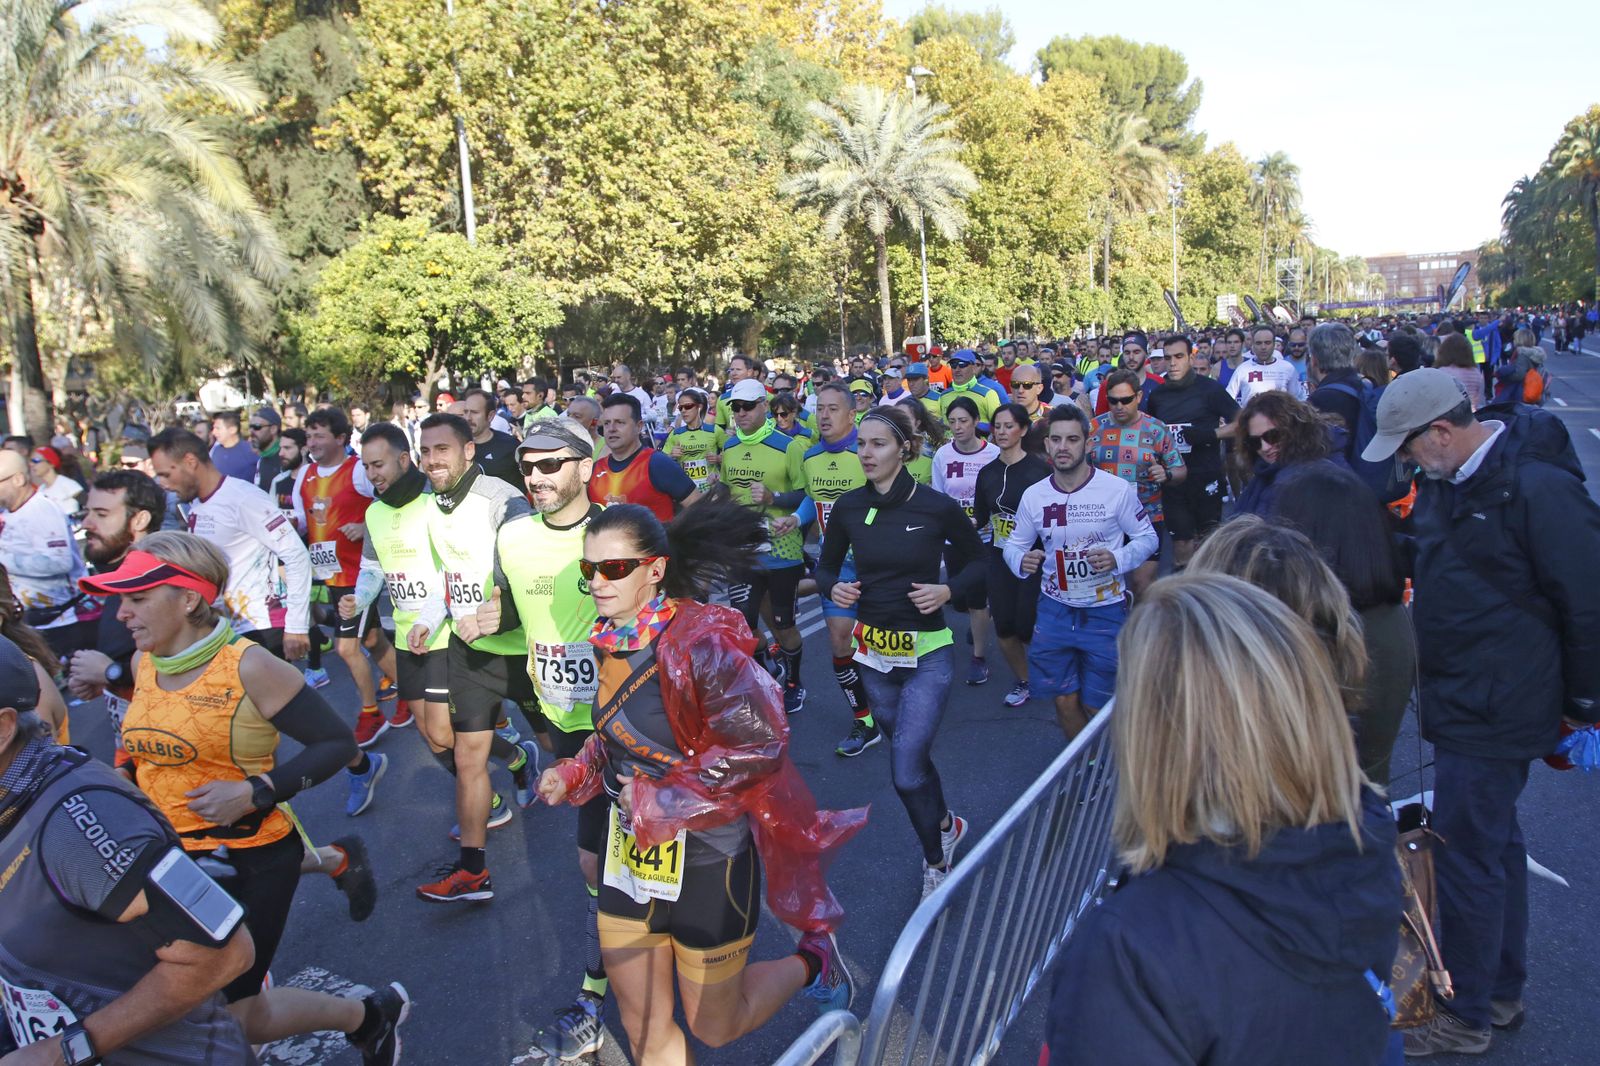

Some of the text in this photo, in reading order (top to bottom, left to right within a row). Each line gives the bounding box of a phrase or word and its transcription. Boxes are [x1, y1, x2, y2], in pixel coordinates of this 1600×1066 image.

[727, 466, 766, 478] Htrainer
[812, 476, 853, 487] Htrainer
[1067, 510, 1107, 518] MARATÓN
[311, 550, 337, 566] 6085
[1066, 560, 1098, 579] 40
[389, 580, 428, 601] 5043
[864, 626, 914, 651] 4308
[537, 657, 595, 685] 7359
[573, 685, 598, 693] CORRAL
[124, 738, 185, 760] GALBIS
[624, 834, 679, 874] 441
[647, 873, 679, 885] AGUILERA
